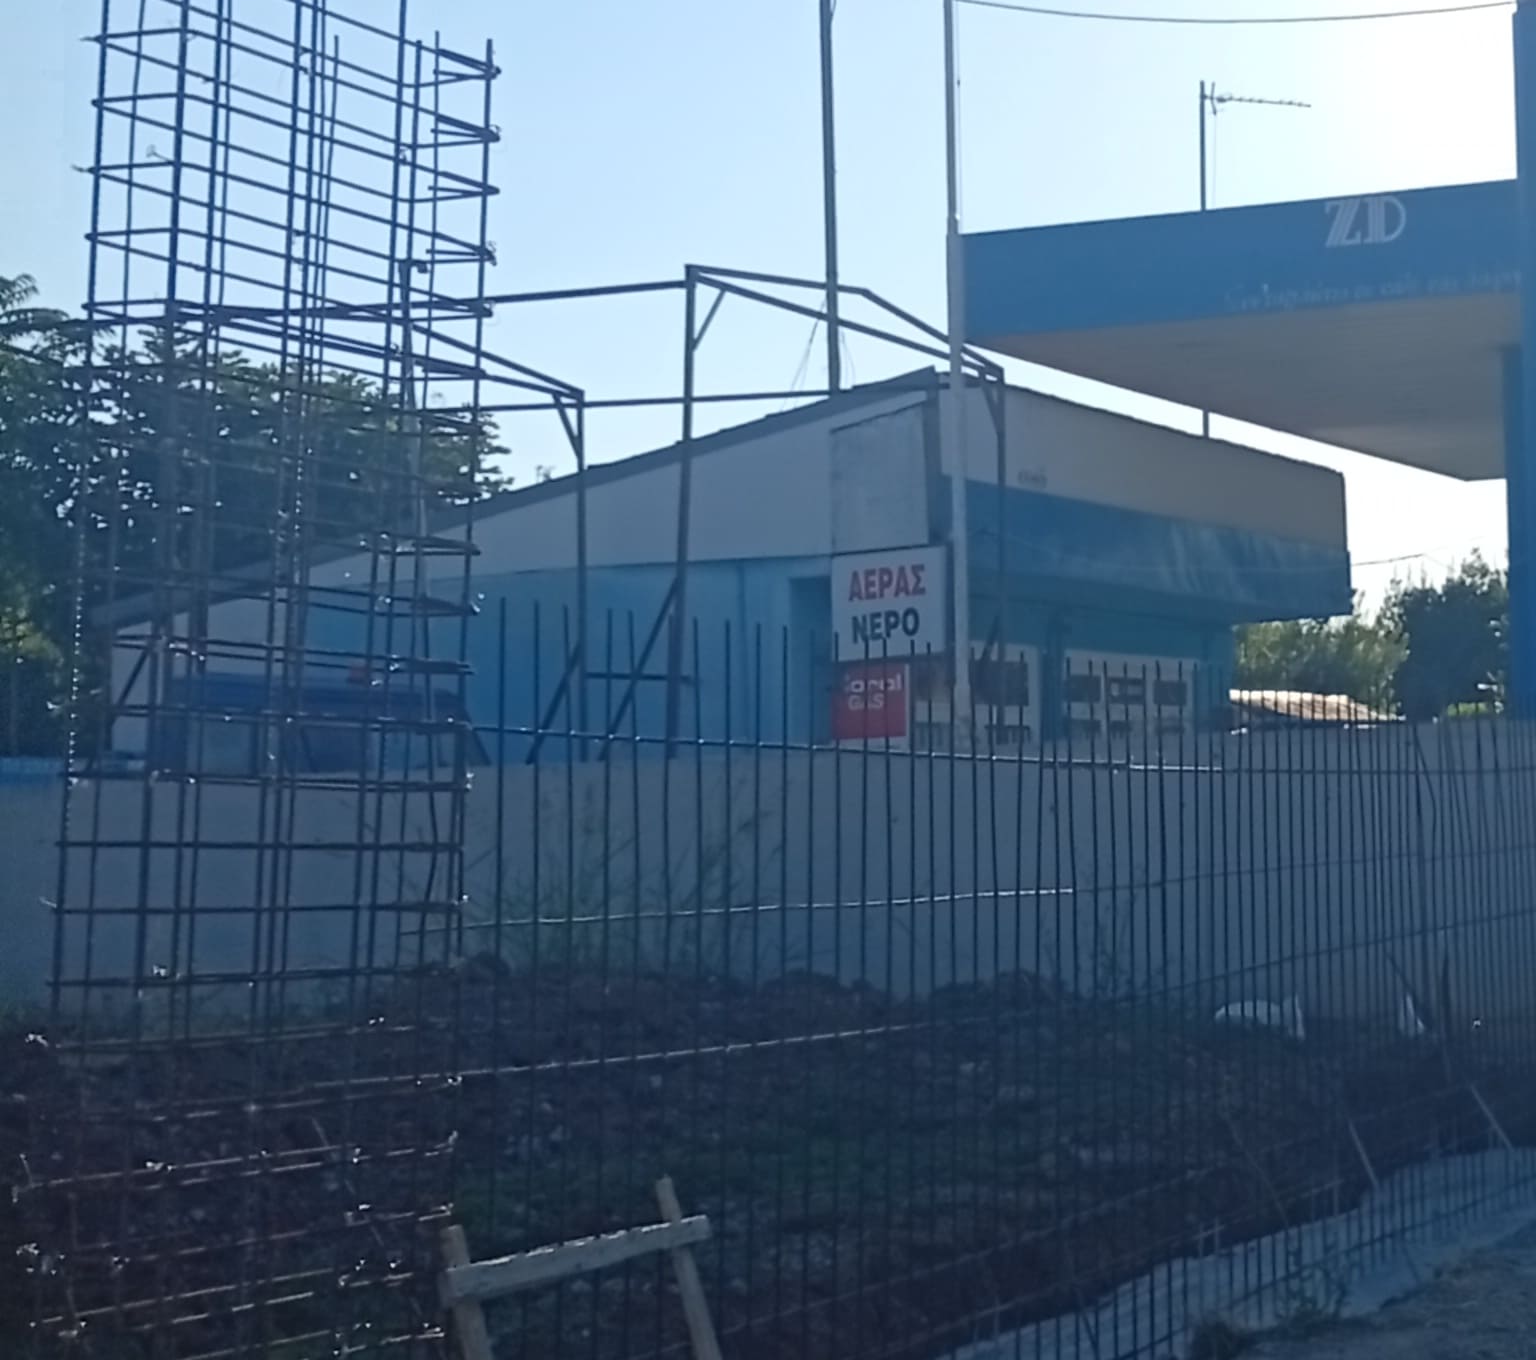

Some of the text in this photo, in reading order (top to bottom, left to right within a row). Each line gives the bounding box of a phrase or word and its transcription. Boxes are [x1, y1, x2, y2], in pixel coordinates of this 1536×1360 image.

[1324, 195, 1407, 248] ZD
[848, 563, 927, 602] ΑΕΡΑΣ
[851, 606, 921, 644] ΝΕΡΟ
